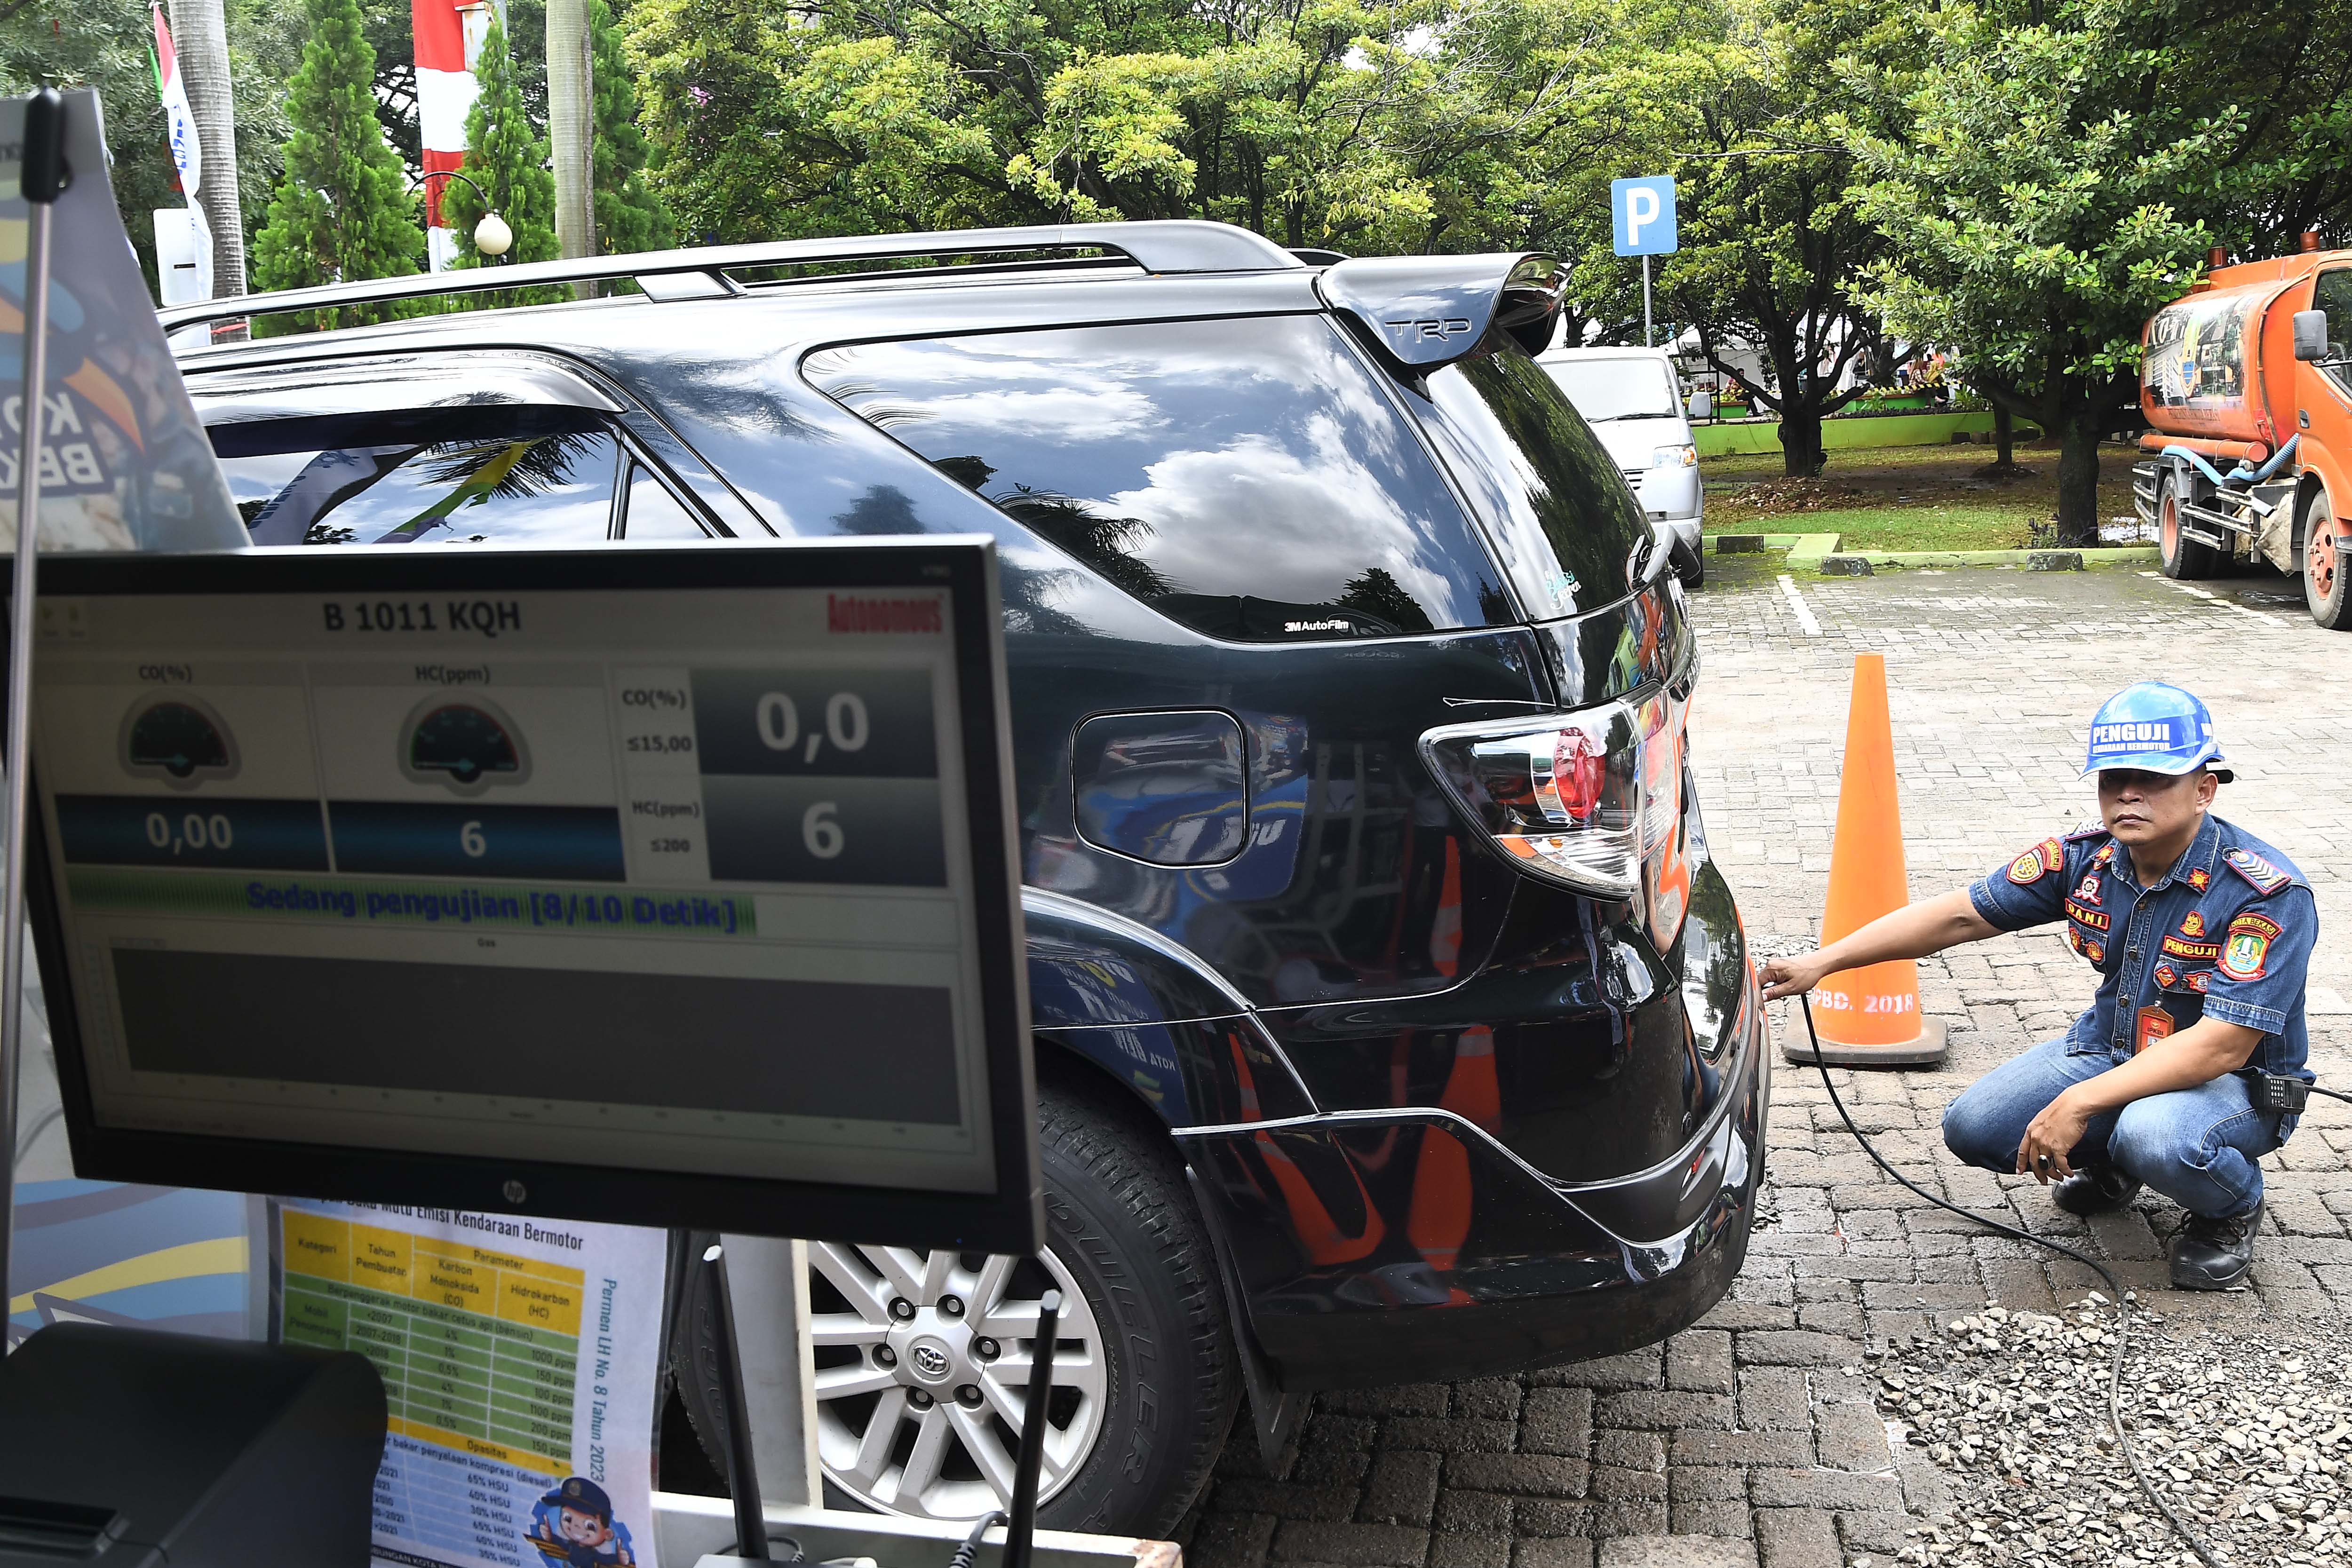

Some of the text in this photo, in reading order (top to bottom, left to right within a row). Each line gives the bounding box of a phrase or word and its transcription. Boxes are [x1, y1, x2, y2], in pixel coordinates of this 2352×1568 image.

[1626, 187, 1660, 246] P
[1385, 317, 1473, 343] TRD
[324, 602, 521, 637] B 1011 KQH
[826, 594, 944, 634] Autonomous
[1284, 619, 1349, 632] 3M AutoFilm
[138, 664, 193, 683] CO(%)
[415, 665, 491, 686] HC(ppm)
[622, 689, 686, 711] CO(%)
[755, 691, 870, 765] 0,0
[2092, 723, 2170, 744] PENGUJI
[632, 800, 700, 819] HC(ppm)
[145, 812, 234, 855] 0,00
[459, 821, 487, 858] 6
[802, 802, 845, 859] 6
[246, 881, 738, 934] Sedang pengujian [8/10 Detik]
[2250, 918, 2276, 935] BEKASI
[2165, 938, 2217, 957] PENGUJI
[1863, 993, 1914, 1015] 2018
[2147, 1027, 2164, 1036] IPKBI
[504, 1180, 526, 1204] hp
[454, 1207, 520, 1238] Kendaraan
[524, 1222, 583, 1251] Bermotor
[297, 1237, 337, 1254] Kategori
[369, 1243, 396, 1259] Tahun
[356, 1256, 407, 1277] Pembuatan
[438, 1258, 473, 1276] Karbon
[473, 1249, 524, 1270] Parameter
[430, 1274, 480, 1295] Monoksida
[511, 1283, 571, 1307] Hidrokarbon
[444, 1293, 465, 1309] (CO)
[393, 1299, 421, 1313] motor
[422, 1305, 449, 1320] bakar
[451, 1313, 476, 1328] cetus
[528, 1304, 550, 1320] (HC)
[532, 1349, 577, 1371] 1000 ppm
[536, 1369, 575, 1389] 150 ppm
[590, 1278, 617, 1483] Permen LH No. 8 Tahun 2023
[535, 1387, 574, 1407] 100 ppm
[551, 1412, 572, 1425] ppm
[531, 1421, 572, 1442] 200 ppm
[393, 1437, 419, 1453] bakar
[421, 1446, 468, 1466] penyalaan
[469, 1457, 514, 1479] kompresi
[467, 1439, 508, 1460] Opasitas
[532, 1440, 572, 1460] 150 ppm
[488, 1479, 509, 1493] HSU
[489, 1496, 511, 1509] HSU
[491, 1510, 513, 1524] HSU
[493, 1526, 515, 1539] HSU
[496, 1540, 518, 1553] HSU
